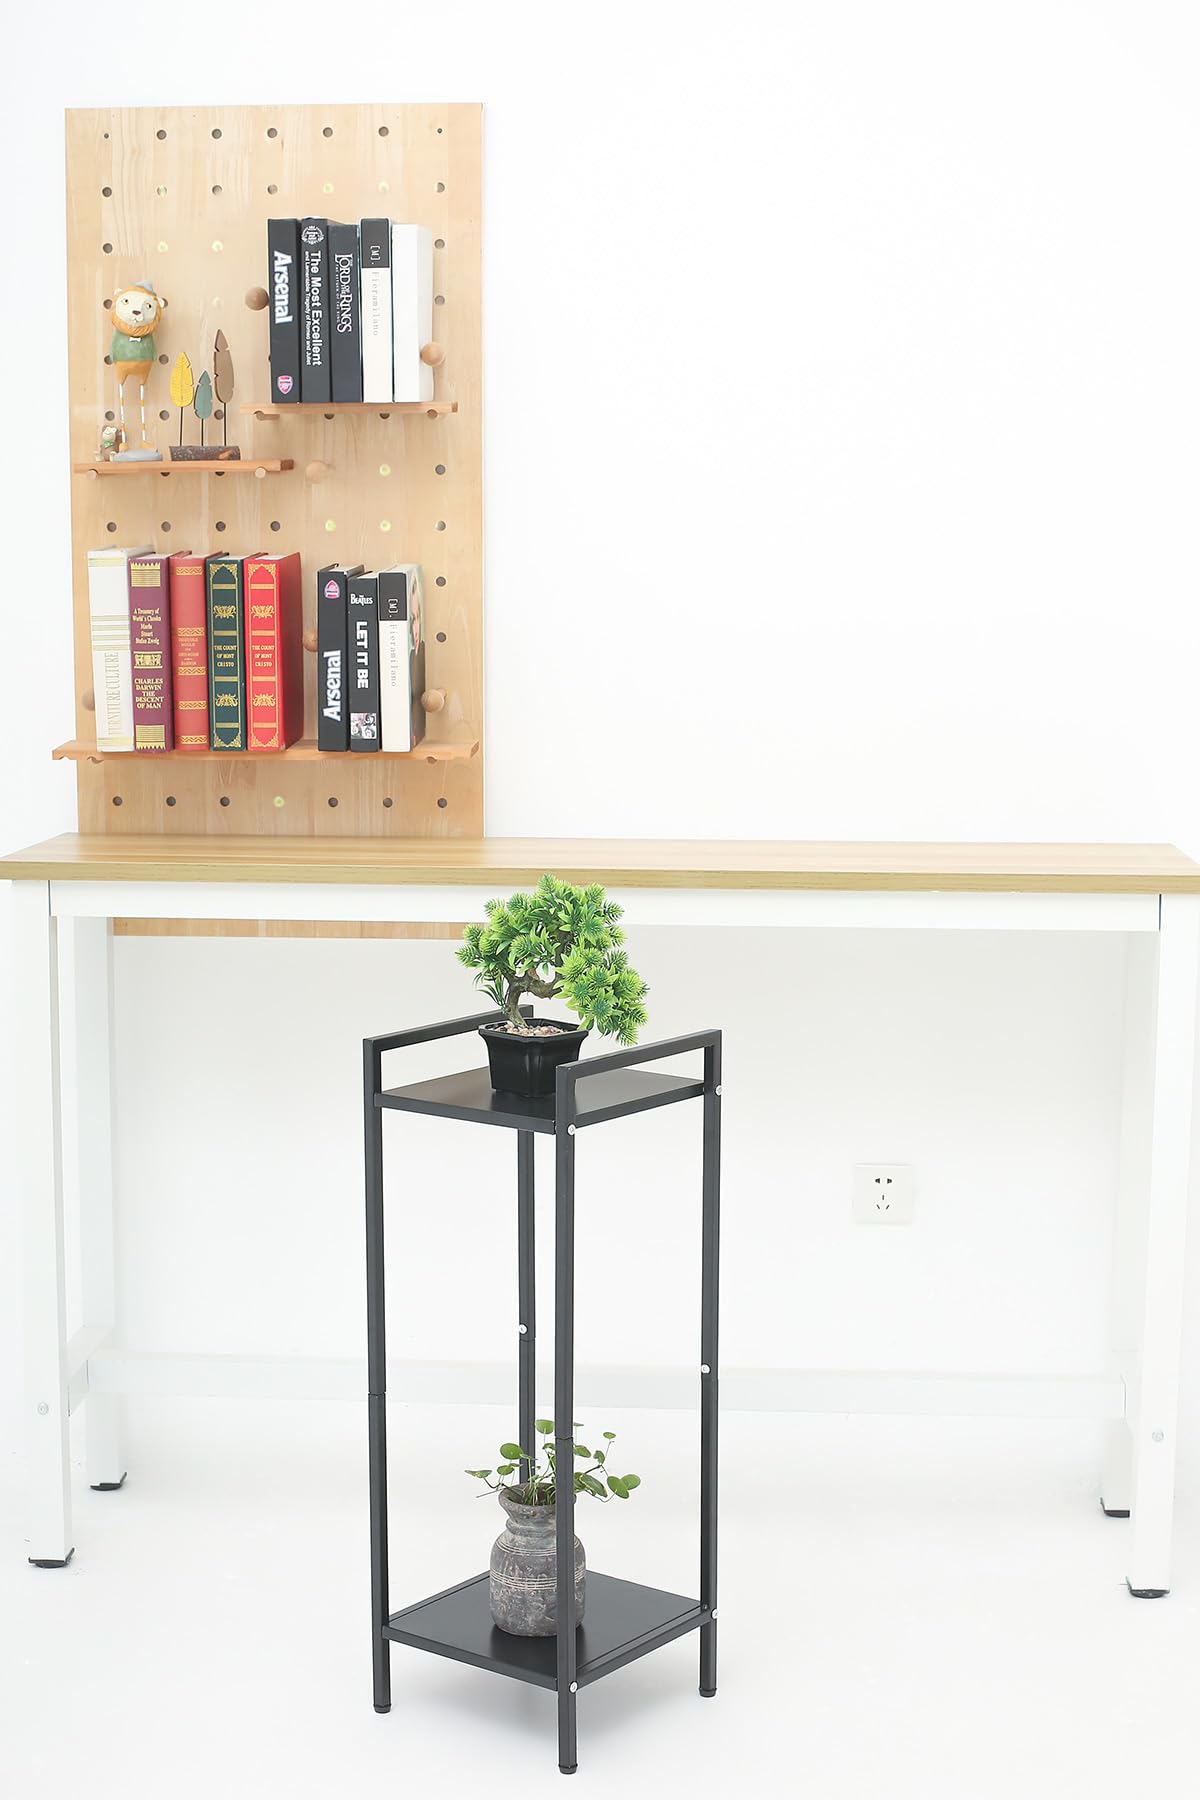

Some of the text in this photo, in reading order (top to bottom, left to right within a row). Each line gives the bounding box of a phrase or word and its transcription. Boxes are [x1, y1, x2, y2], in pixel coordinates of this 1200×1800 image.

[274, 250, 293, 324] Arsenal
[335, 254, 353, 285] LORD
[310, 250, 322, 366] The Most Excellent
[336, 293, 353, 332] RINGS
[104, 652, 120, 689] CULTURE
[323, 650, 341, 722] Arsenal
[356, 621, 369, 689] LET IT BE
